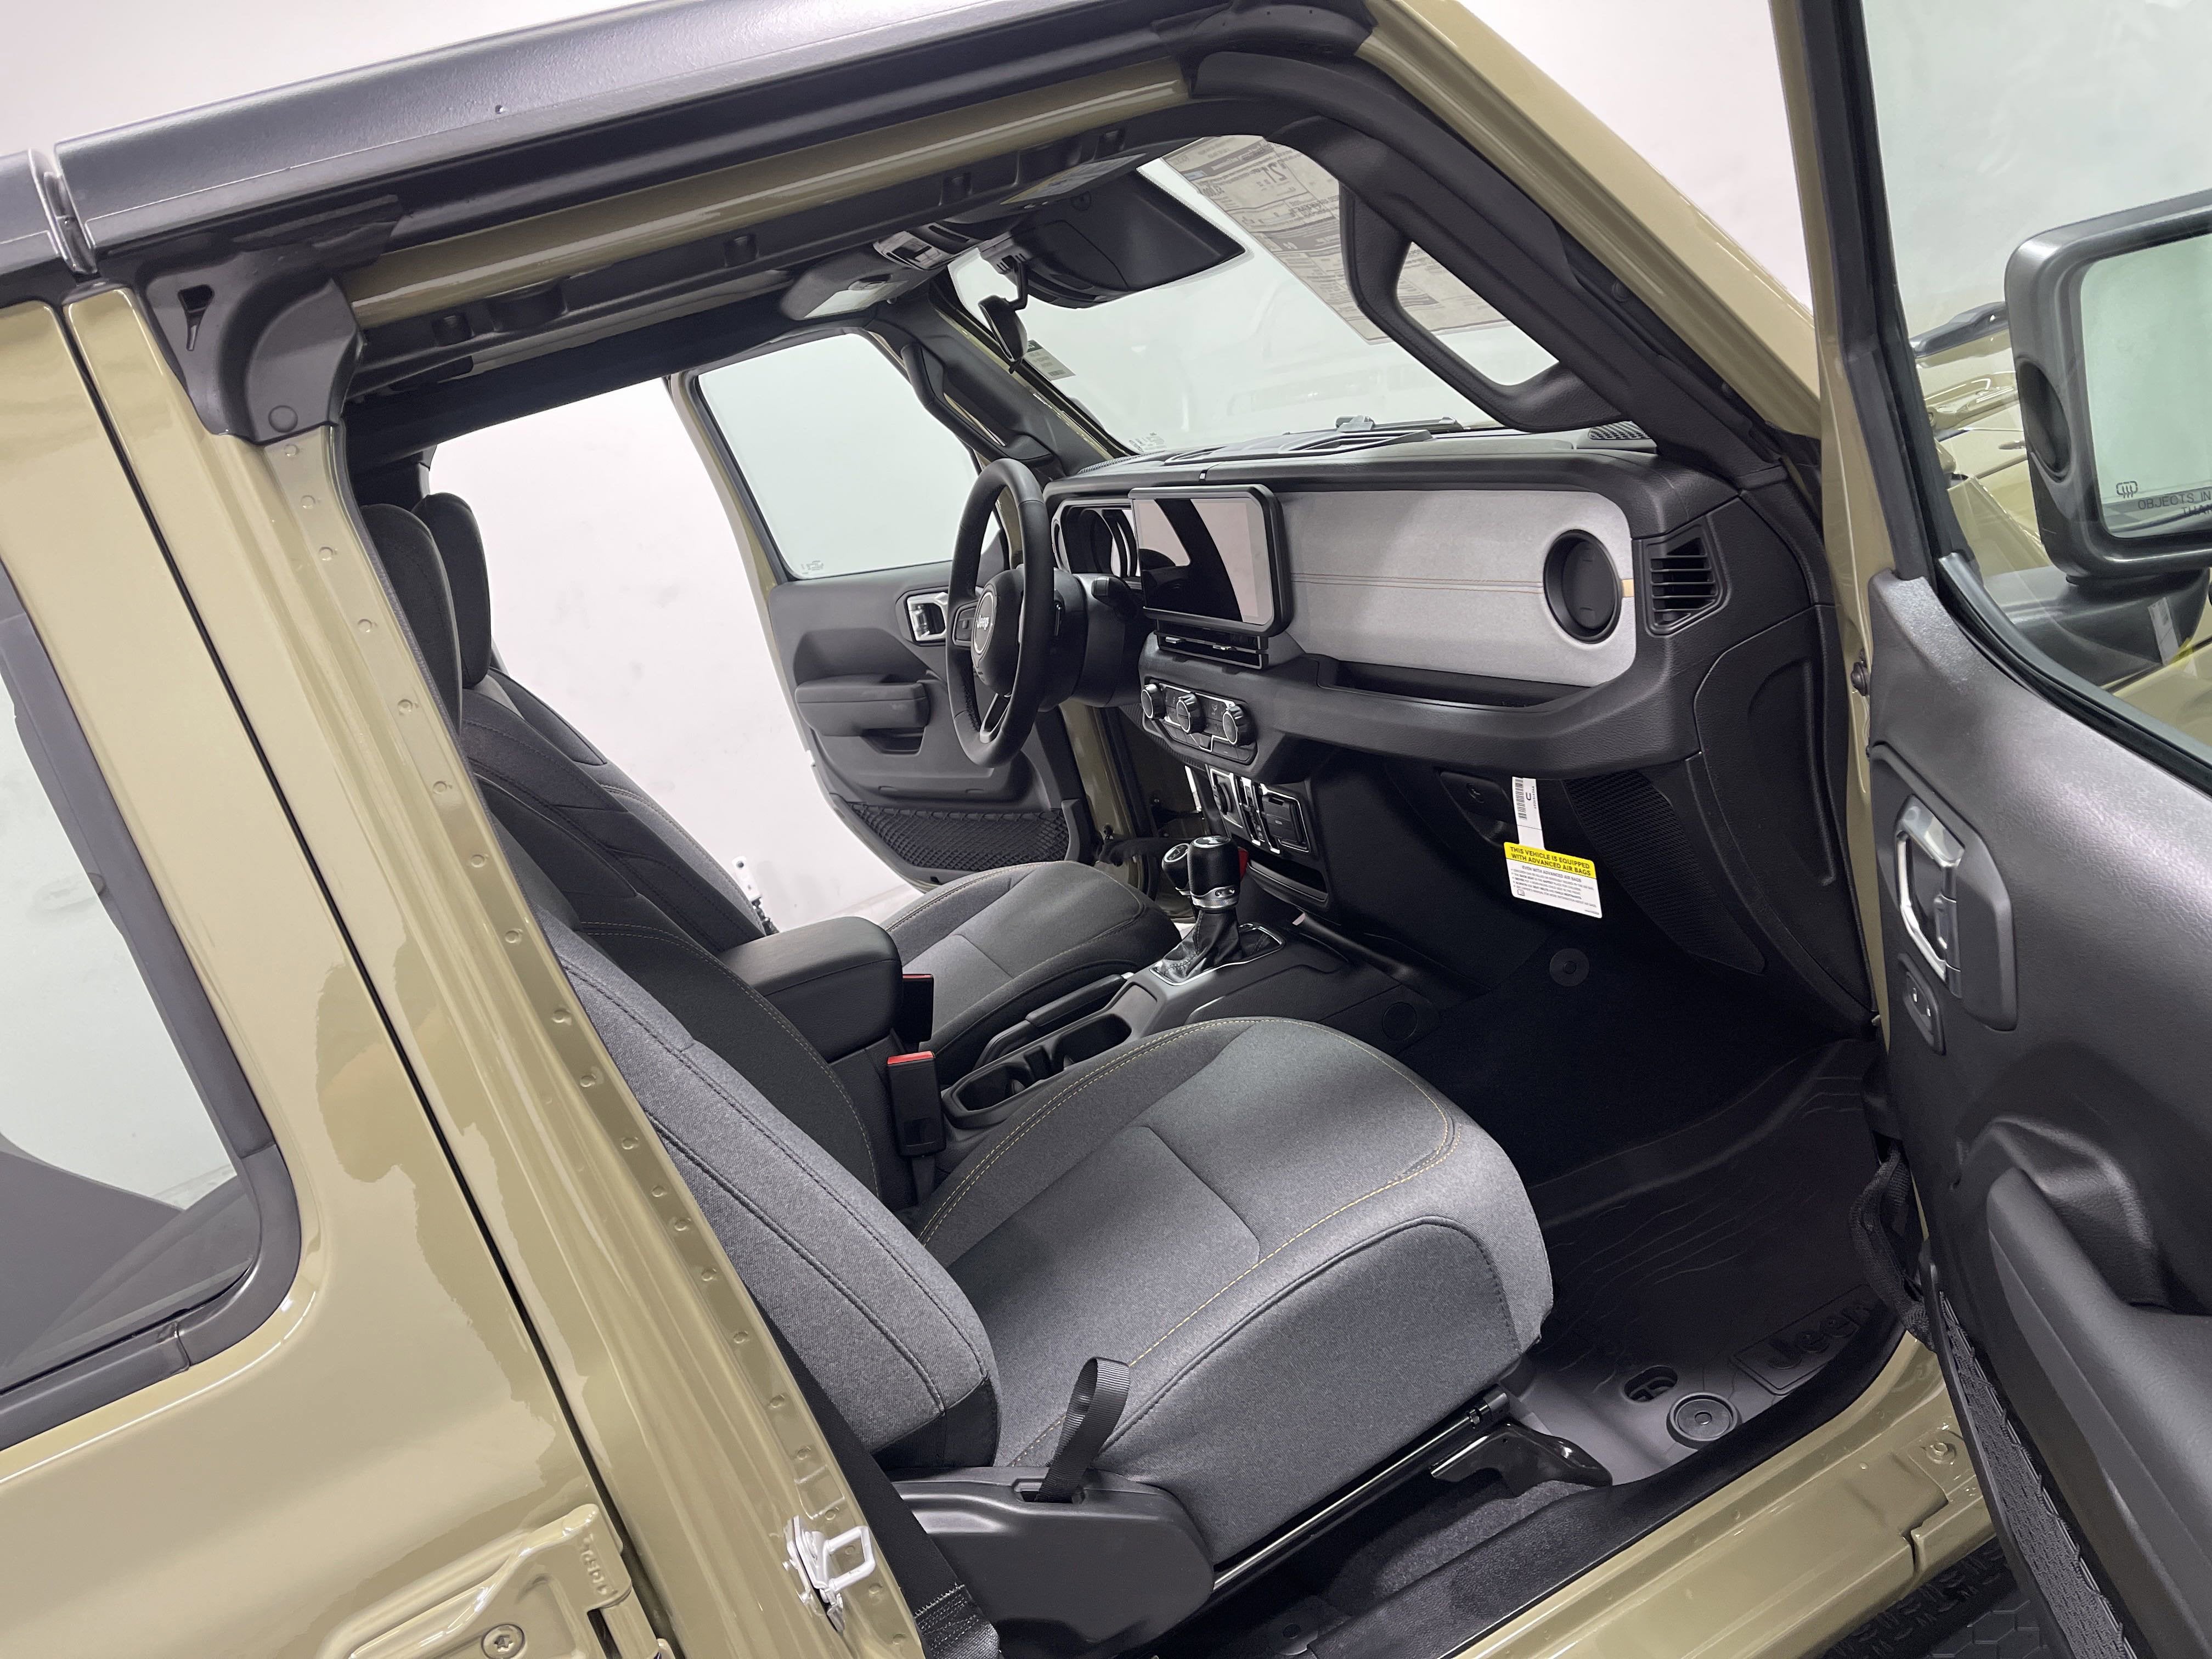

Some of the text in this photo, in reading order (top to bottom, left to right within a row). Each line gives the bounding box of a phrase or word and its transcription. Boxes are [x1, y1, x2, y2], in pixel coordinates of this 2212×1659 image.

[2137, 493, 2194, 510] OBJECTS
[977, 614, 989, 630] Jeep
[1525, 792, 1531, 801] U
[1511, 853, 1527, 861] WITH
[1528, 857, 1561, 868] ADVANCED
[1575, 867, 1591, 876] BAGS
[1525, 850, 1550, 860] VEHICLE
[1559, 857, 1590, 869] EQUIPPED
[1543, 870, 1564, 878] ADVANCED
